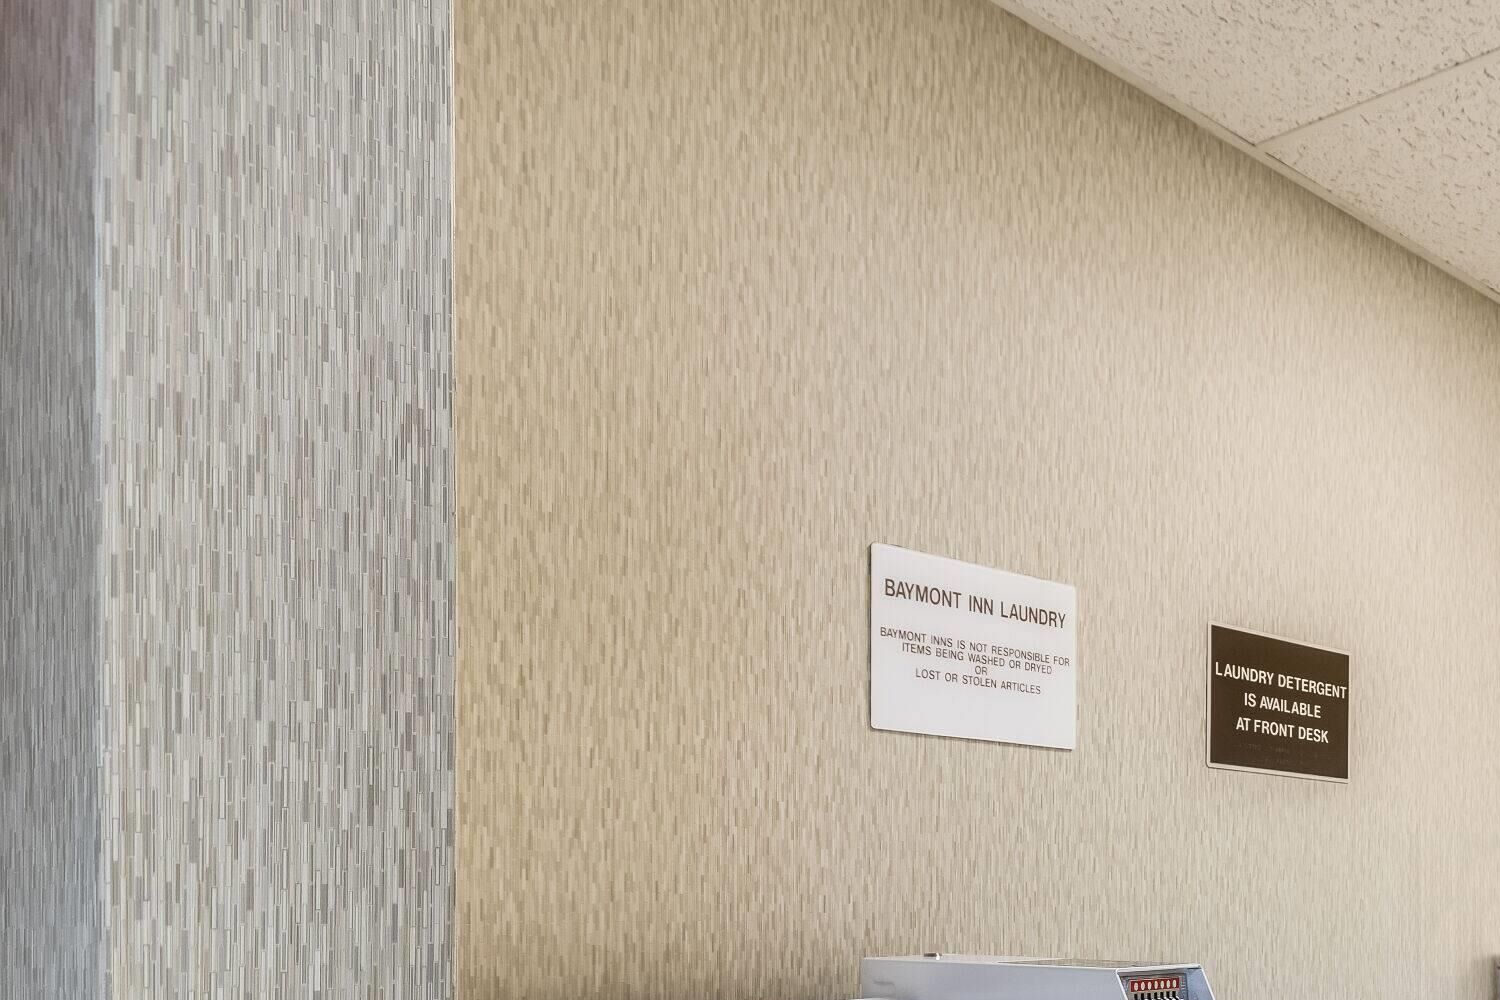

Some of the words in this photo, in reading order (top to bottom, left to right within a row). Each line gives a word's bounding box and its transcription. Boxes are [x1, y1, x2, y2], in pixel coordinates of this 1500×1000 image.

[884, 578, 962, 609] BAYMONT
[968, 594, 994, 616] INN
[1000, 601, 1066, 629] LAUNDRY
[880, 626, 927, 643] BAYMONT
[930, 635, 953, 648] INNS
[957, 640, 966, 650] IS
[969, 642, 988, 653] NOT
[991, 645, 1051, 664] RESPONSIBLE
[1053, 655, 1070, 667] FOR
[902, 642, 932, 656] ITEMS
[935, 647, 964, 661] BEING
[968, 652, 1006, 668] WASHED
[1009, 659, 1021, 669] OR
[1024, 661, 1053, 675] DRYED
[915, 667, 941, 681] LOST
[944, 672, 958, 683] OR
[962, 675, 997, 689] STOLEN
[1000, 680, 1041, 695] ARTICLES
[974, 665, 988, 676] OR
[1215, 661, 1275, 686] LAUNDRY
[1277, 673, 1348, 699] DETERGENT
[1244, 692, 1257, 708] IS
[1259, 695, 1322, 719] AVAILABLE
[1235, 716, 1252, 732] AT
[1253, 719, 1295, 739] FRONT
[1298, 726, 1329, 744] DESK
